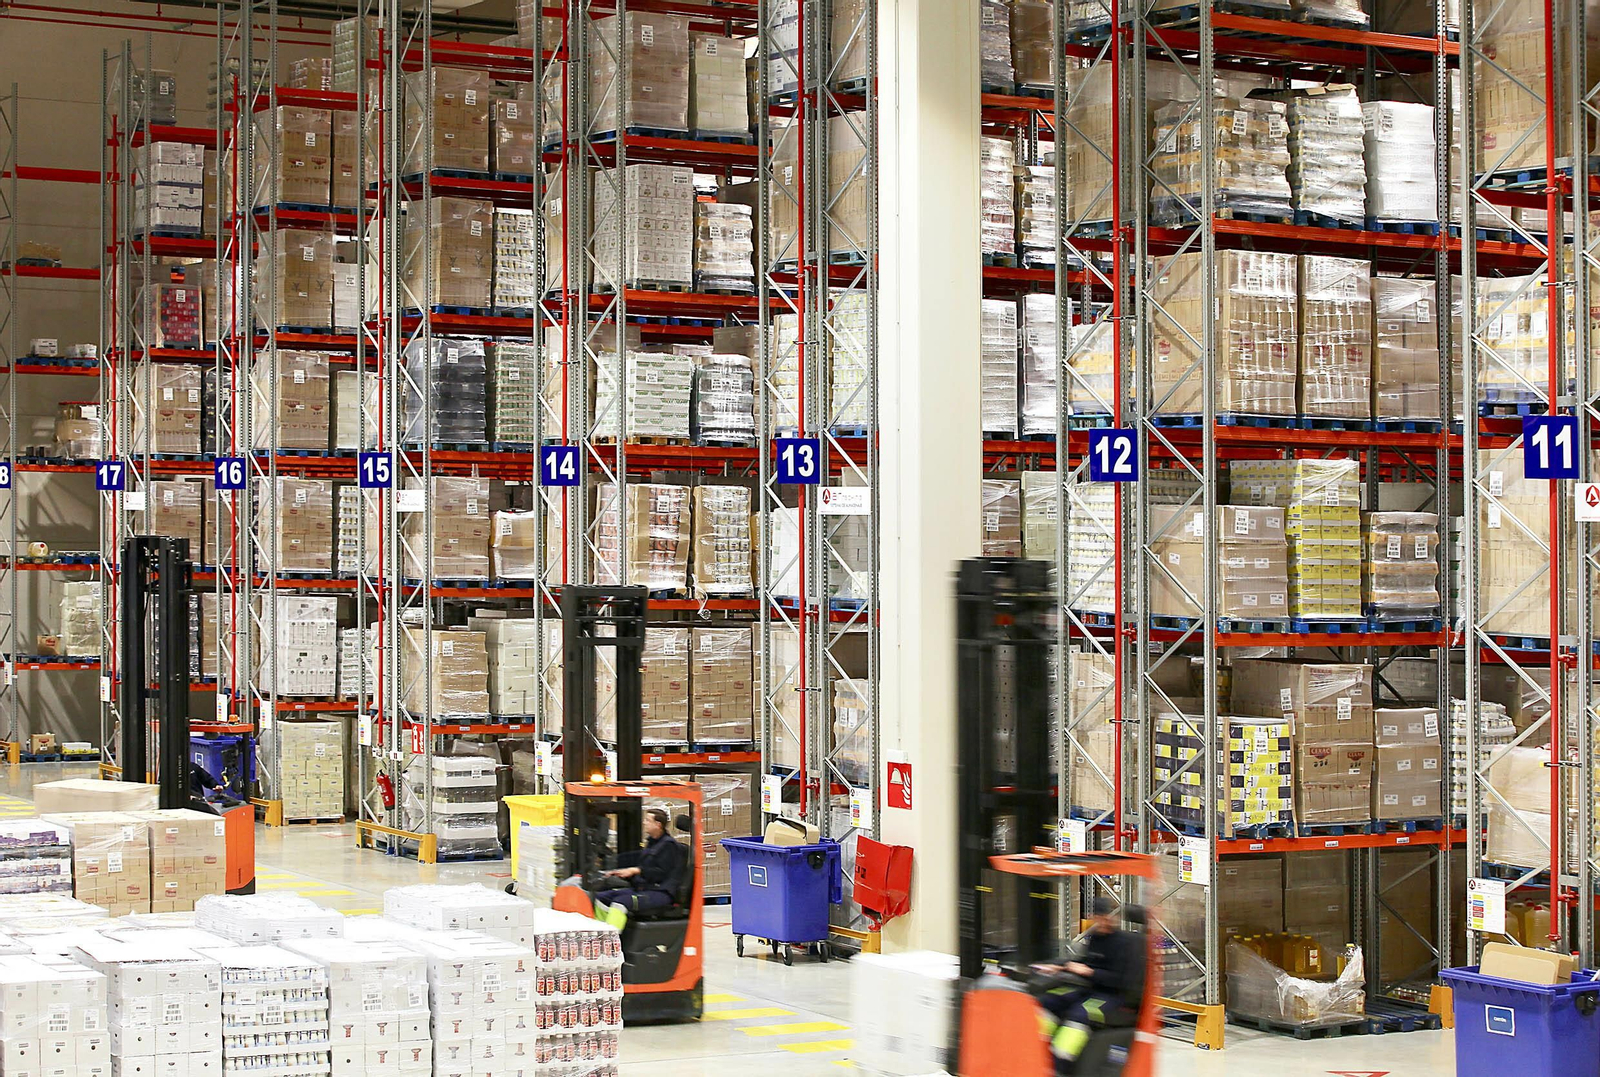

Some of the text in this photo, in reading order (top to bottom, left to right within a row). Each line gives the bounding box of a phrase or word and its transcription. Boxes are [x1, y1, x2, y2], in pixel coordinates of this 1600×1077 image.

[782, 444, 815, 477] 13
[1095, 435, 1132, 474] 12
[1531, 424, 1572, 469] 11
[98, 464, 122, 486] 17
[217, 461, 242, 485] 16
[363, 456, 390, 483] 15
[545, 451, 575, 480] 14
